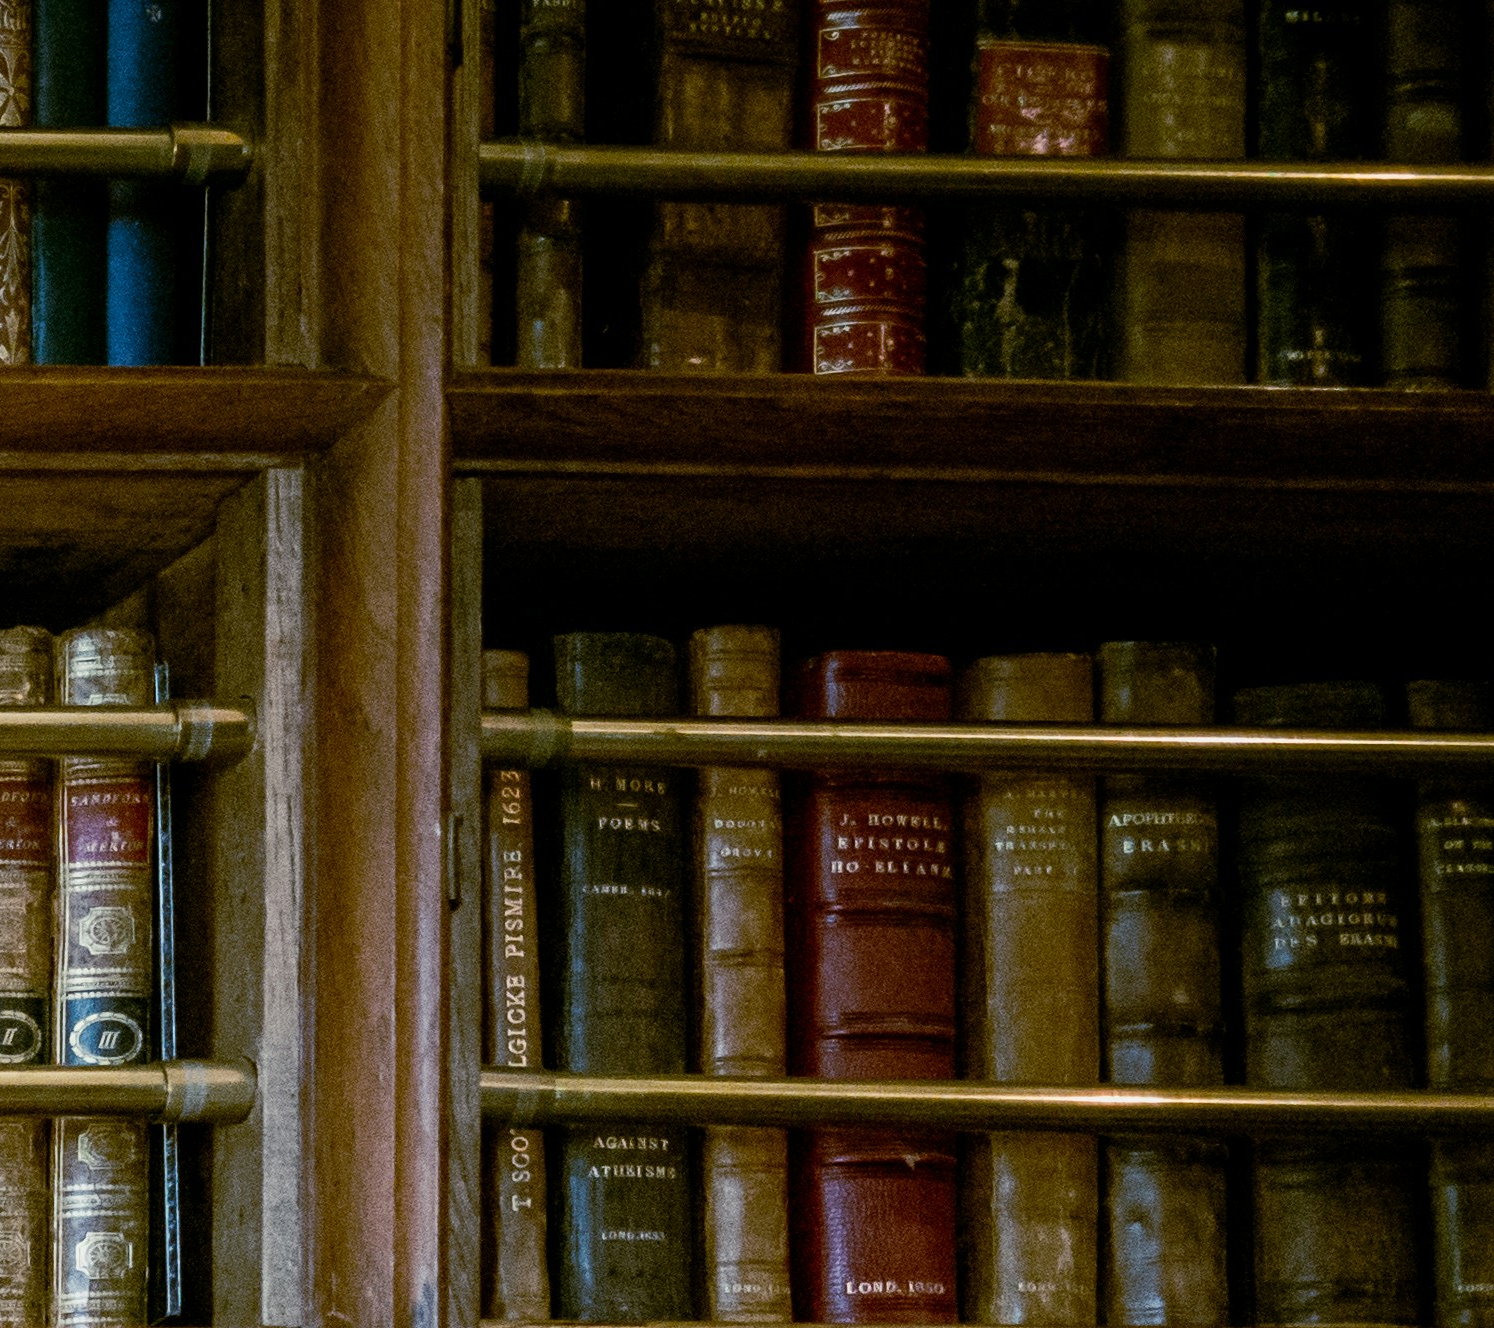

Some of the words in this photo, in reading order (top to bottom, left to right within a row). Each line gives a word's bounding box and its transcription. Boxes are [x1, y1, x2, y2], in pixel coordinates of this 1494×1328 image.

[501, 770, 520, 824] 1623
[598, 818, 661, 832] POEMS
[99, 1031, 120, 1049] III
[594, 1136, 669, 1152] AGAINST
